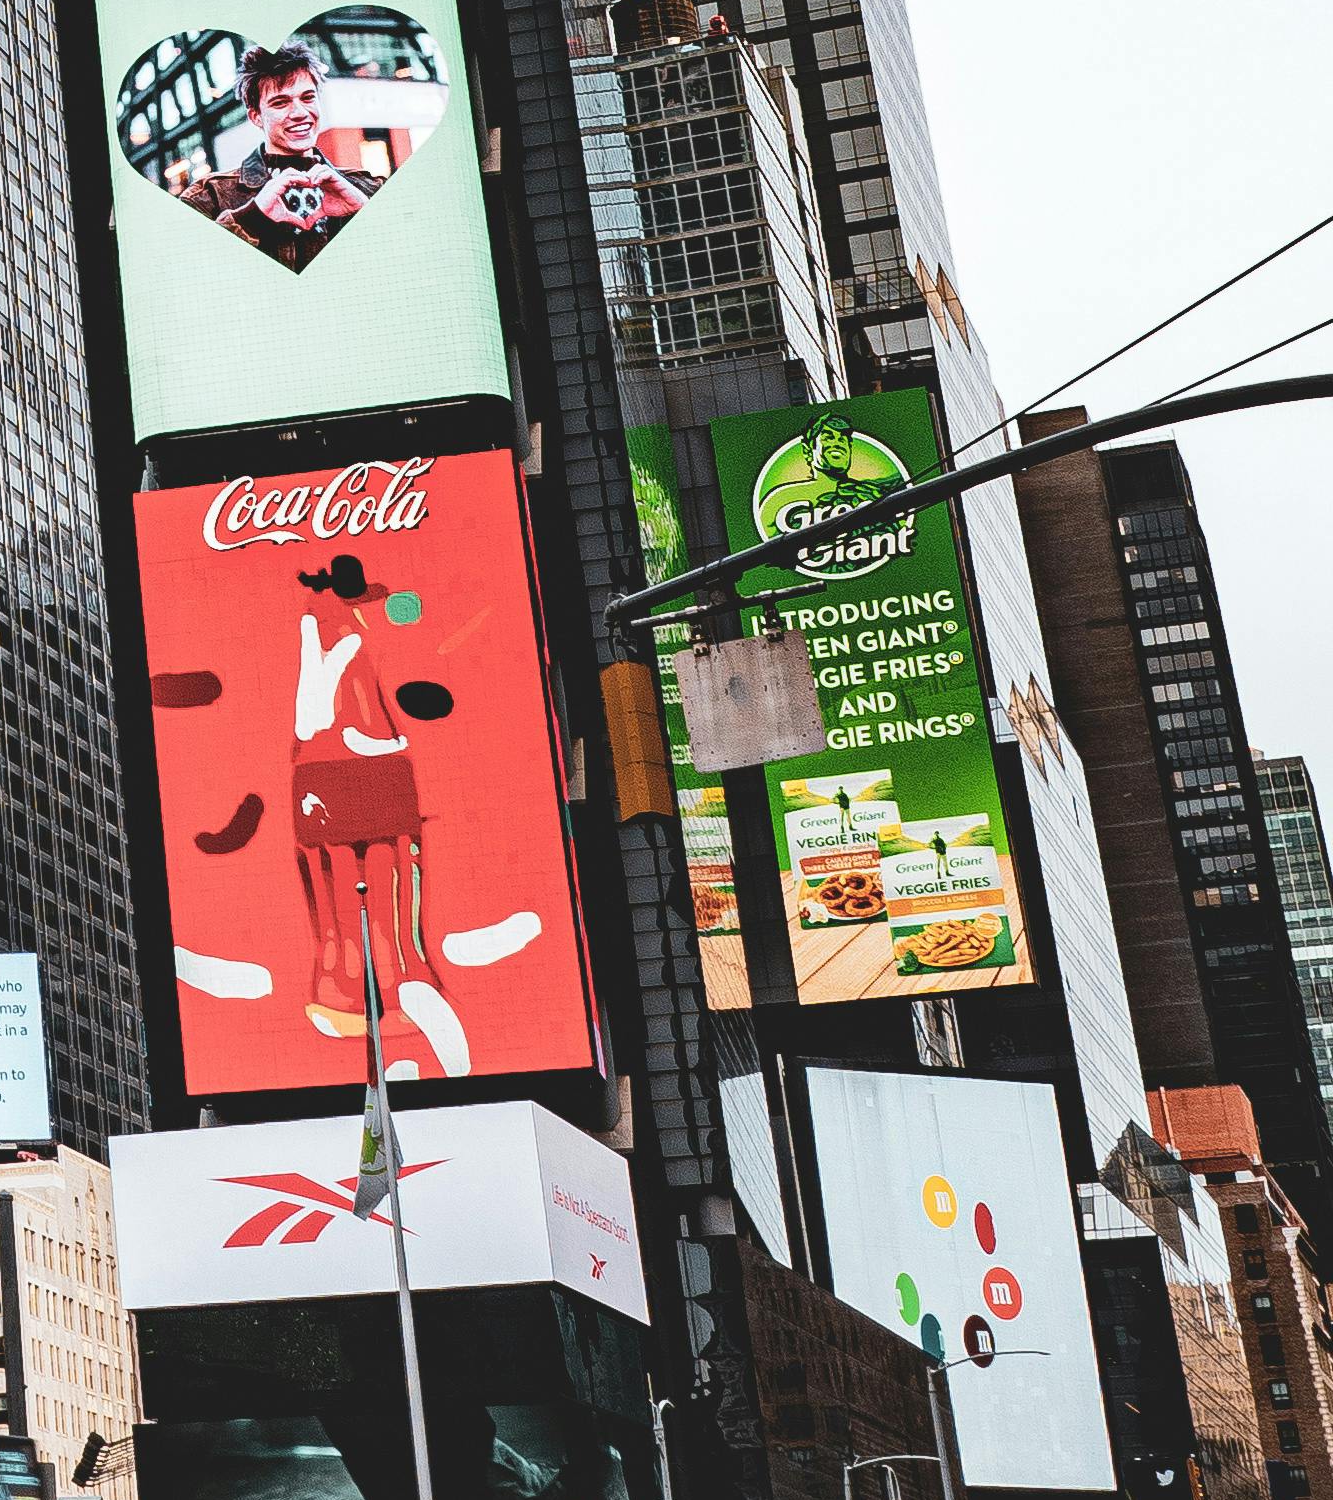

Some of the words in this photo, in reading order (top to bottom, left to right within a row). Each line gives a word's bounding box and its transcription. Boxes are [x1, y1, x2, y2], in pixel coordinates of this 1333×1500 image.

[201, 456, 434, 551] Coca-Cola
[839, 692, 897, 719] AND
[800, 817, 837, 829] Green
[852, 810, 886, 823] Giant
[796, 835, 847, 849] VEGGIE
[895, 862, 933, 874] Green
[949, 856, 984, 868] Giant
[894, 881, 947, 896] VEGGIE
[952, 877, 990, 890] FRIES
[0, 1004, 26, 1017] may
[5, 1025, 17, 1036] in
[20, 1028, 28, 1036] a
[11, 1070, 25, 1081] to
